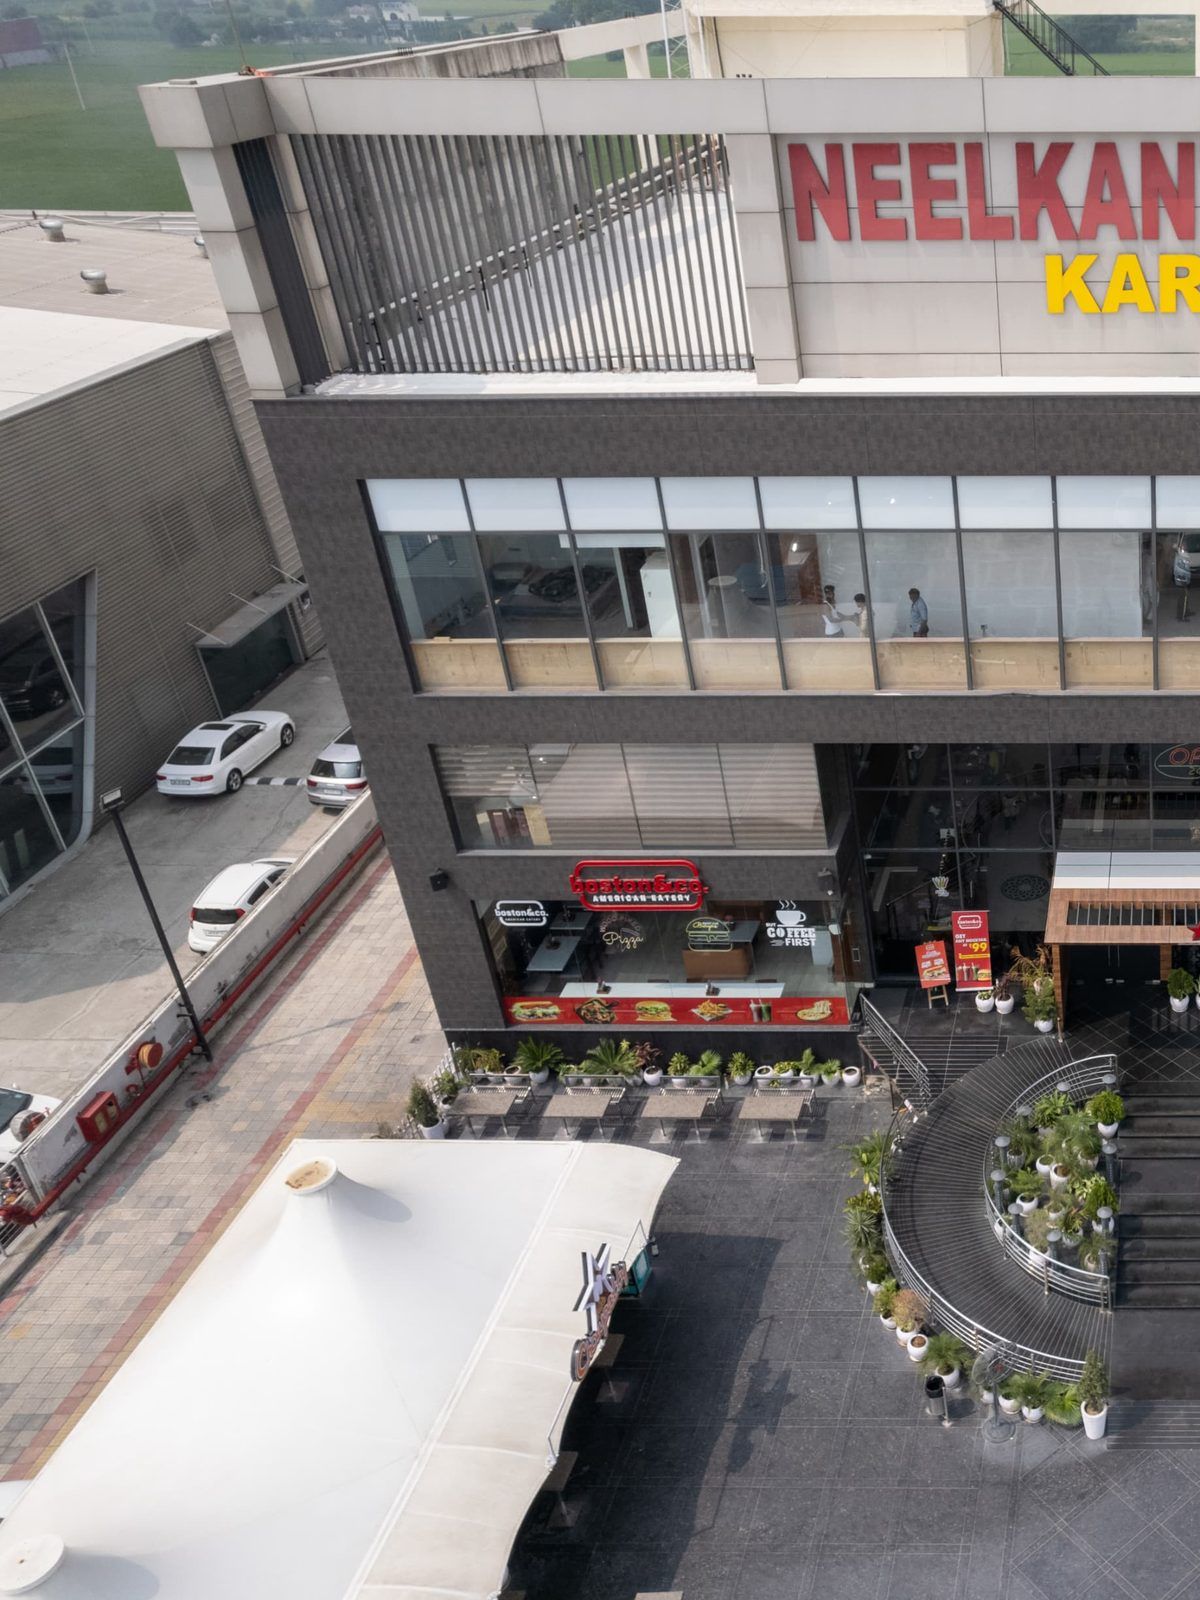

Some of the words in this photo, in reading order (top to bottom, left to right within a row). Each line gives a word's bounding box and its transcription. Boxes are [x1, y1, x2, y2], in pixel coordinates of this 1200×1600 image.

[569, 874, 709, 895] boston&co.
[592, 894, 647, 903] AMERICAN
[651, 894, 691, 902] EATERY
[766, 927, 816, 938] COFFEE
[602, 931, 644, 949] Pizza
[785, 938, 816, 946] FIRST
